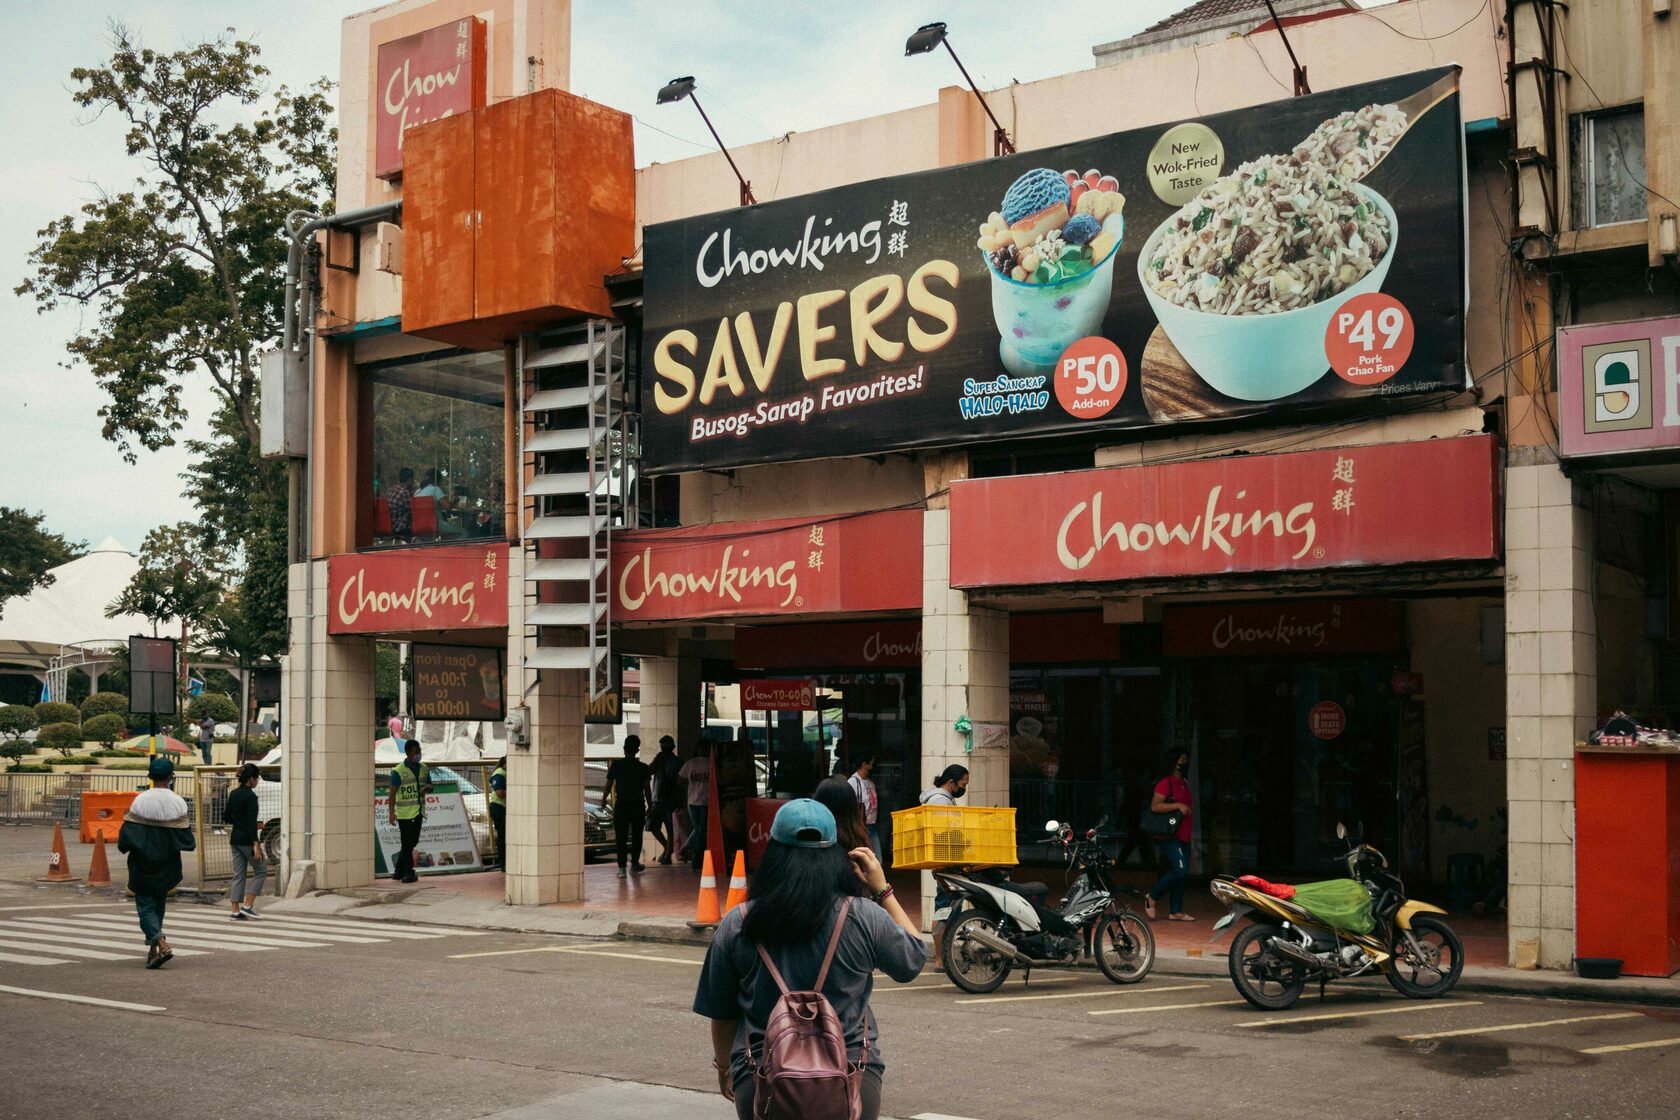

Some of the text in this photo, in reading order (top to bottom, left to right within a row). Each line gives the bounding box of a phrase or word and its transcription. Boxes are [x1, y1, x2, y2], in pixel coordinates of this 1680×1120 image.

[385, 58, 461, 115] Chow
[1153, 154, 1218, 176] Wok-Fried
[1171, 142, 1200, 155] New
[1169, 176, 1203, 190] Taste
[887, 200, 910, 258] 超群
[696, 215, 882, 288] Chowking
[653, 259, 961, 415] SAVERS
[1347, 364, 1395, 376] Chao Fan
[1359, 355, 1383, 365] Pork
[691, 365, 924, 440] Busog-Sarap Favorites!
[959, 391, 1050, 420] HALO-HALO
[1072, 397, 1110, 410] Add-on
[1381, 383, 1411, 395] Prices
[1332, 456, 1357, 515] 超群
[1056, 485, 1315, 571] Chowking
[807, 525, 825, 572] 超群
[483, 551, 497, 592] 超群
[619, 545, 796, 611] Chowking
[339, 567, 474, 625] Chowking
[863, 631, 922, 662] Chowk
[1212, 613, 1326, 649] Chowking
[401, 785, 418, 794] POL
